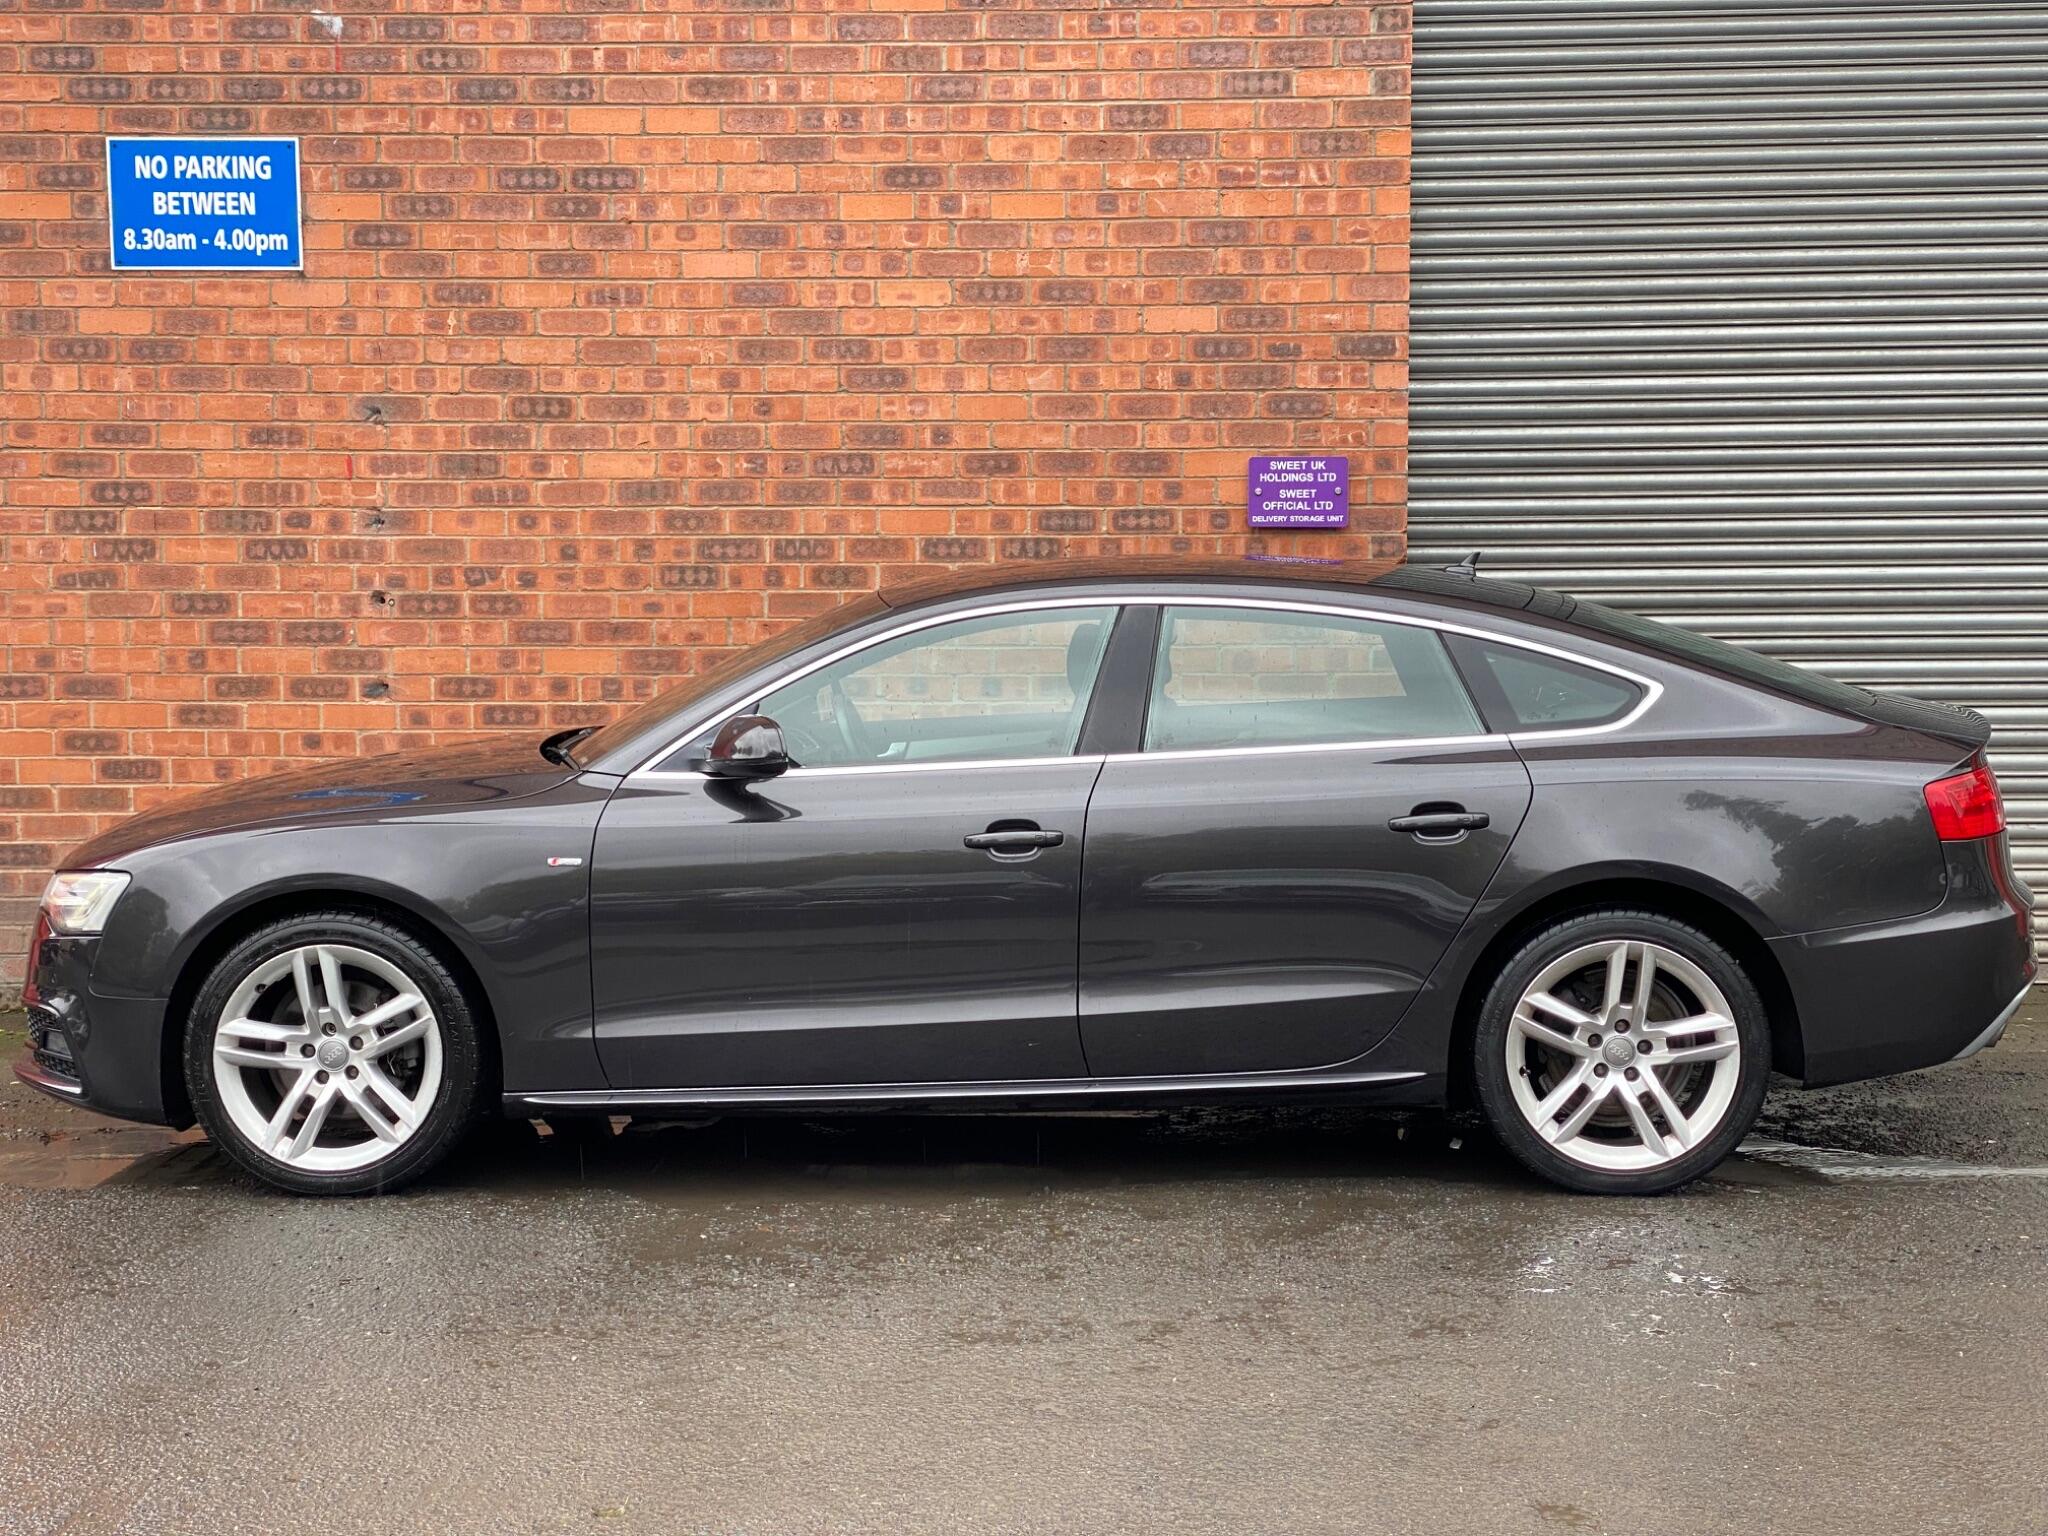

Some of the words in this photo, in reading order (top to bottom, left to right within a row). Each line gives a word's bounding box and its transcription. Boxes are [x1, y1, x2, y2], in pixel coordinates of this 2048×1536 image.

[134, 155, 168, 179] NO
[174, 155, 272, 180] PARKING
[152, 192, 256, 216] BETWEEN
[123, 227, 197, 250] 8.30am
[213, 228, 288, 256] 4.00pm
[1270, 461, 1308, 470] SWEET
[1310, 461, 1326, 470] UK
[1260, 473, 1314, 482] HOLDINGS
[1317, 473, 1337, 482] LTD
[1279, 489, 1317, 498] SWEET
[1262, 501, 1311, 510] OFFICIAL
[1314, 501, 1334, 510] LTD
